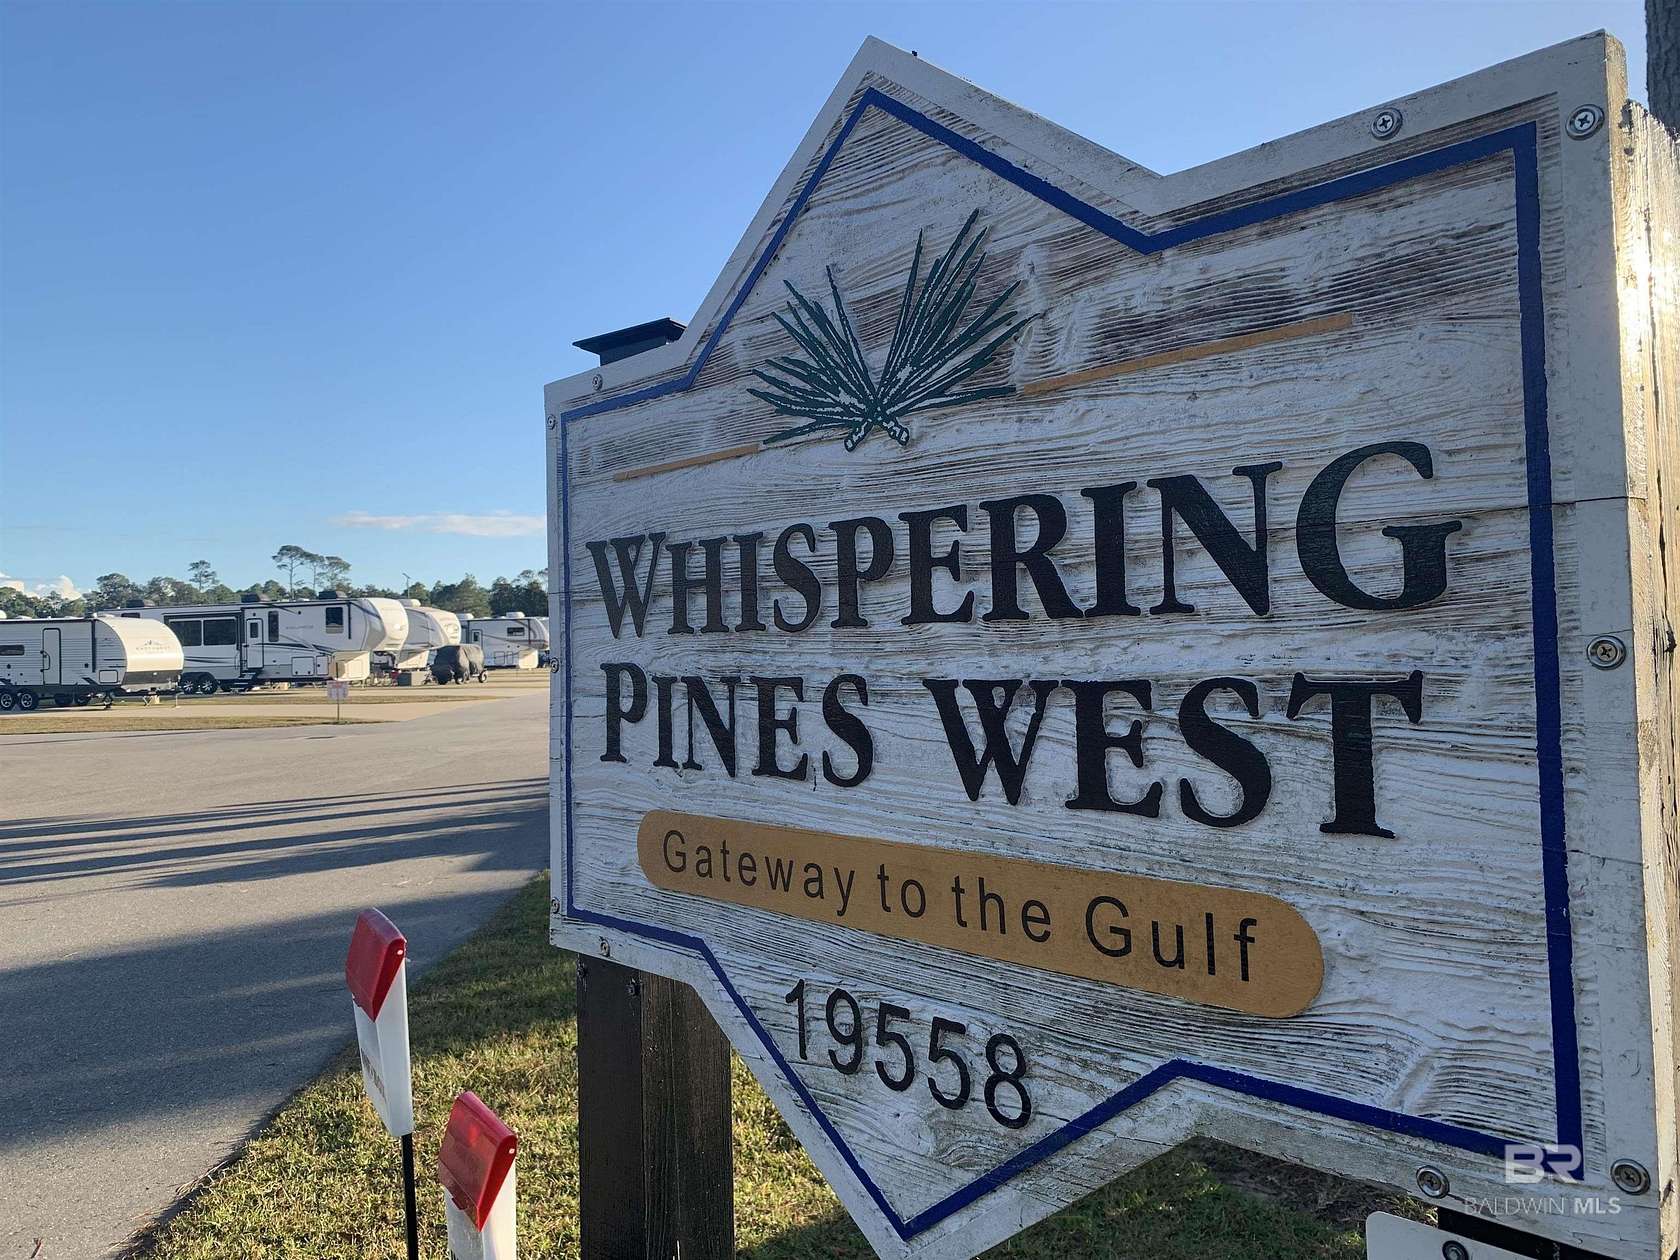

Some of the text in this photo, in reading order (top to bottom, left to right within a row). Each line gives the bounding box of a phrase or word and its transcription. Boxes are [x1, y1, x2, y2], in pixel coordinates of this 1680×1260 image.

[586, 441, 1462, 639] WHISPERING
[600, 662, 1423, 839] PINES WEST
[663, 830, 1257, 982] Gateway to the Gulf
[785, 979, 1032, 1129] 19558
